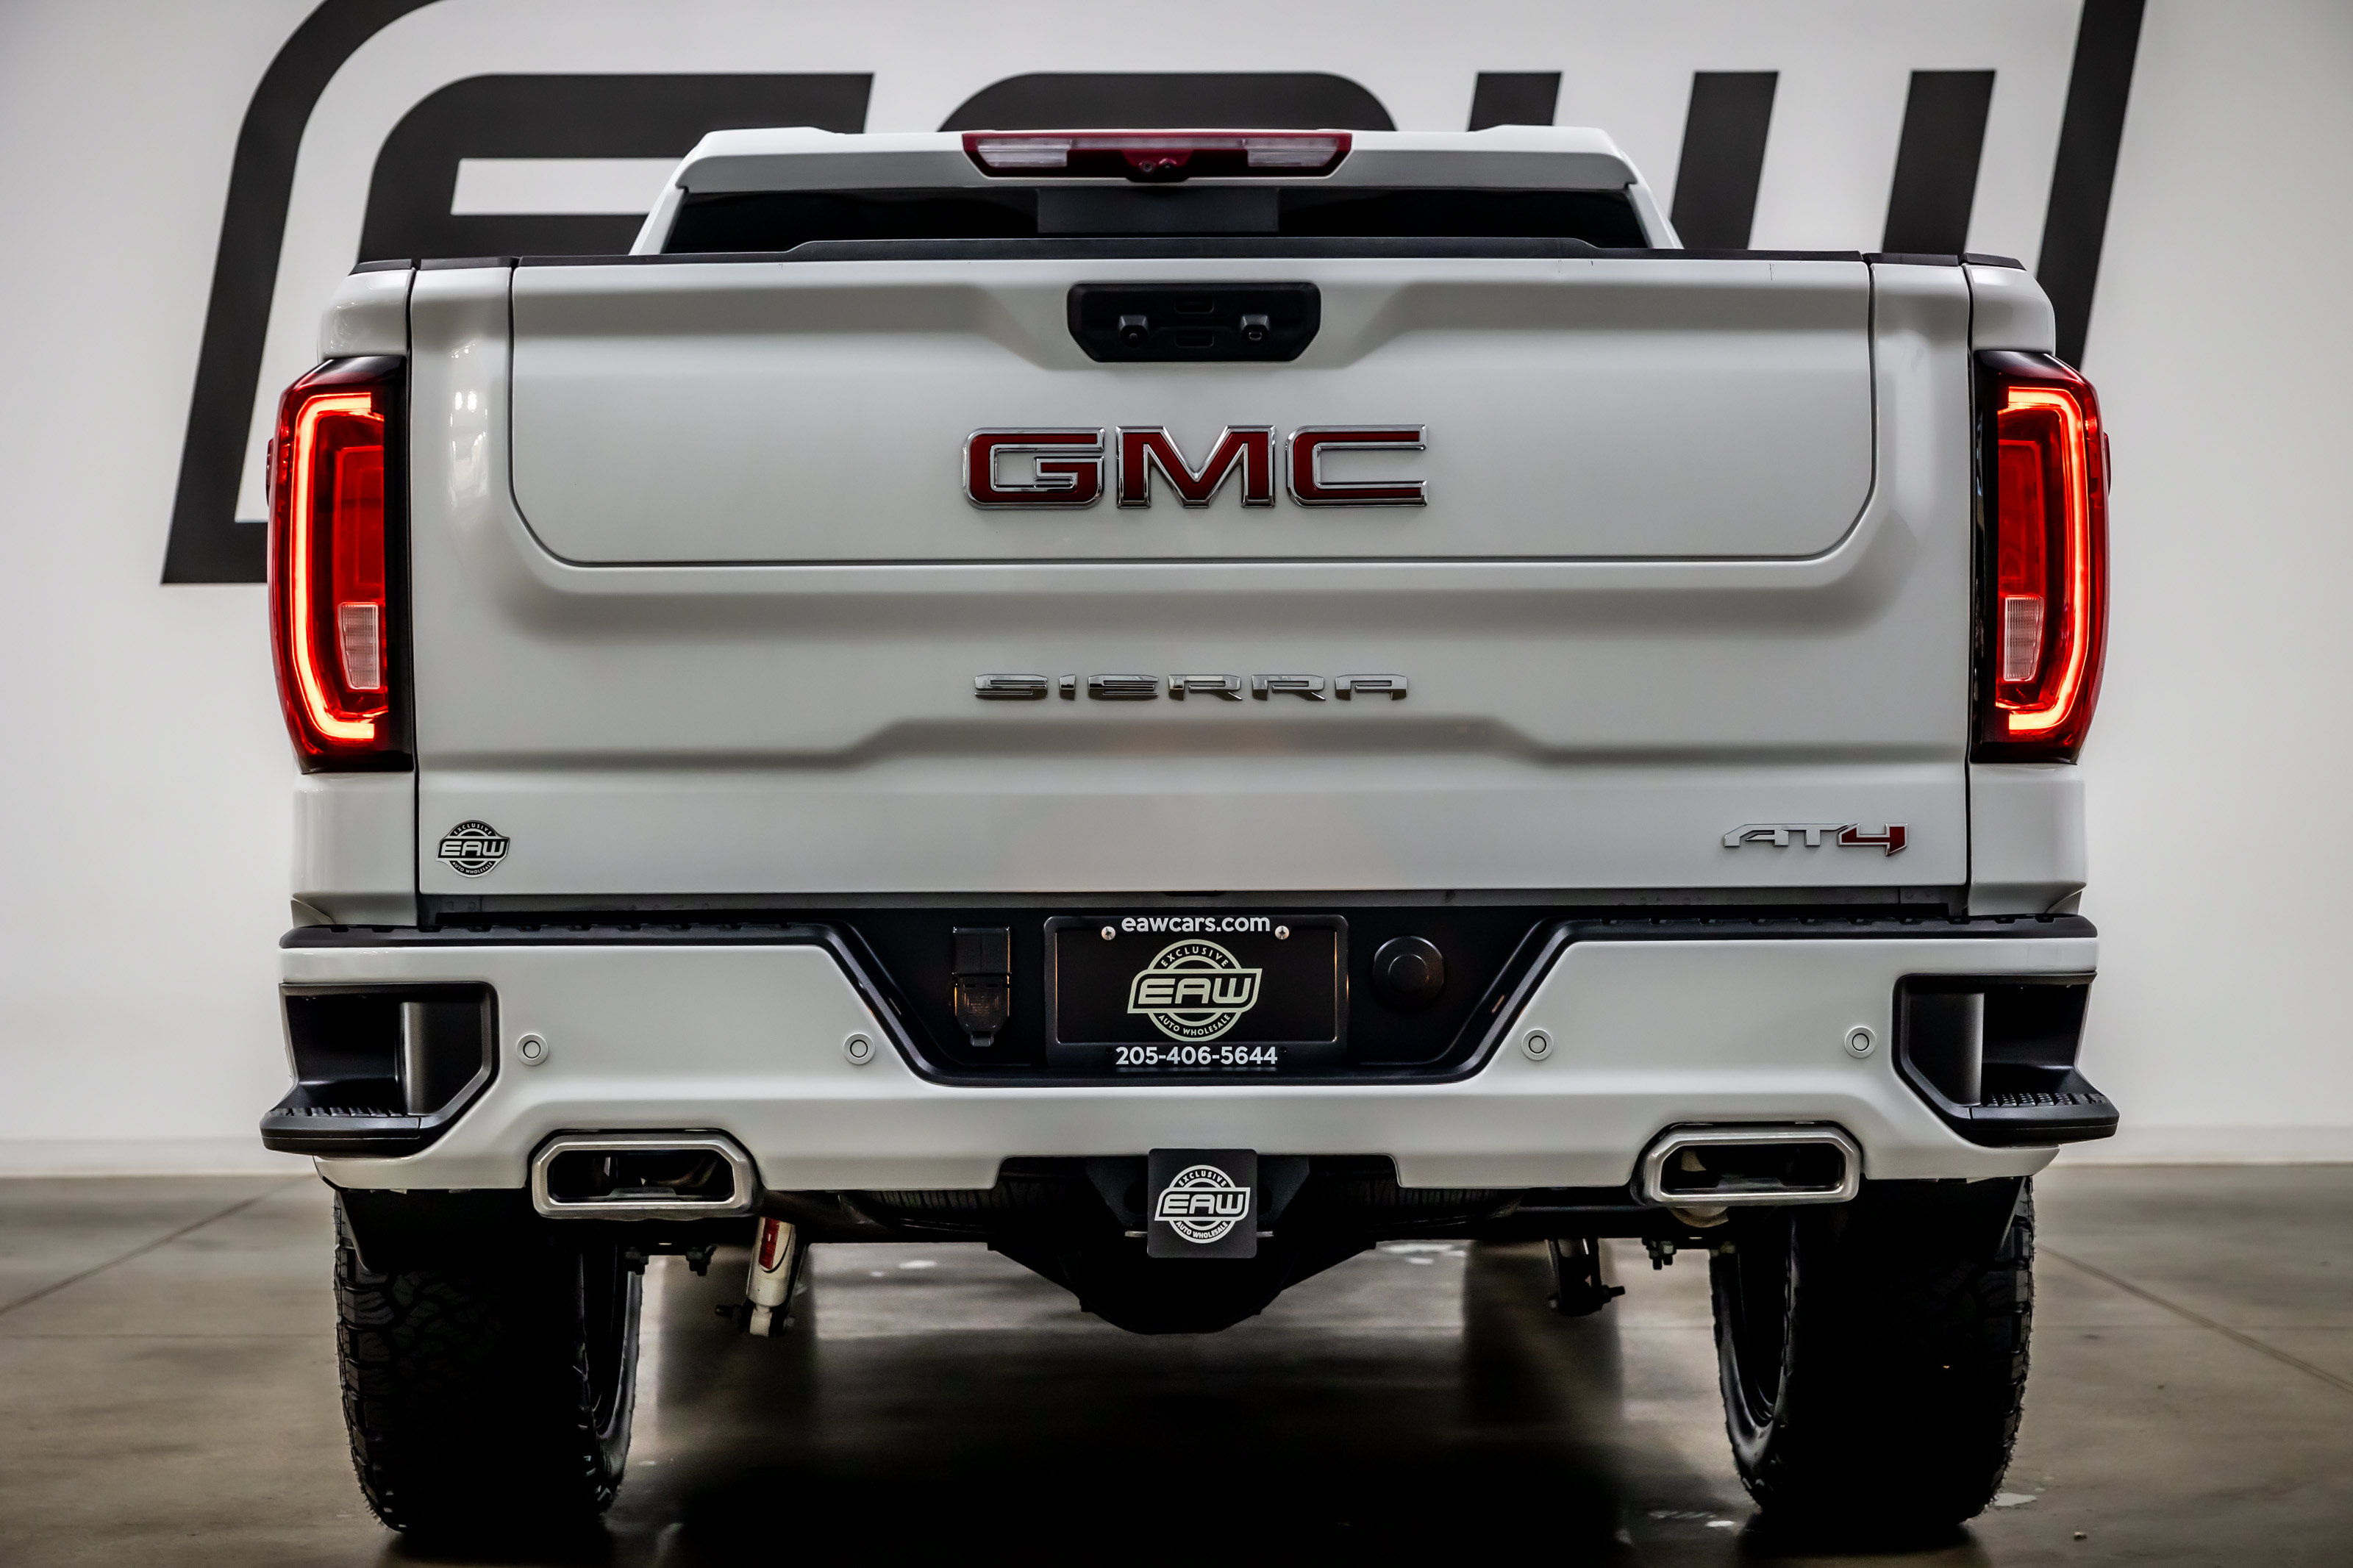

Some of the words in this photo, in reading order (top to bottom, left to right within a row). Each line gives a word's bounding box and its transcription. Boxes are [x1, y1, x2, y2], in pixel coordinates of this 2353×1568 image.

[963, 424, 1428, 509] GMC
[974, 673, 1409, 702] SIERRA
[453, 823, 493, 835] EXCLUSIVE
[440, 841, 505, 856] EAW
[1723, 823, 1909, 856] AT4
[451, 862, 465, 872] AUTO
[465, 862, 493, 874] WHOLESALE
[1121, 917, 1271, 932] eawcars.com
[1160, 946, 1229, 967] EXCLUSIVE
[1138, 978, 1252, 1004] EAW
[1158, 1014, 1180, 1032] AUTO
[1182, 1014, 1232, 1037] WHOLESALE
[1115, 1046, 1278, 1065] 205-406-5644
[1178, 1170, 1227, 1187] EXCLUSIVE
[1163, 1194, 1244, 1214] EAW
[1176, 1221, 1192, 1235] AUTO
[1192, 1221, 1229, 1239] WHOLESALE
